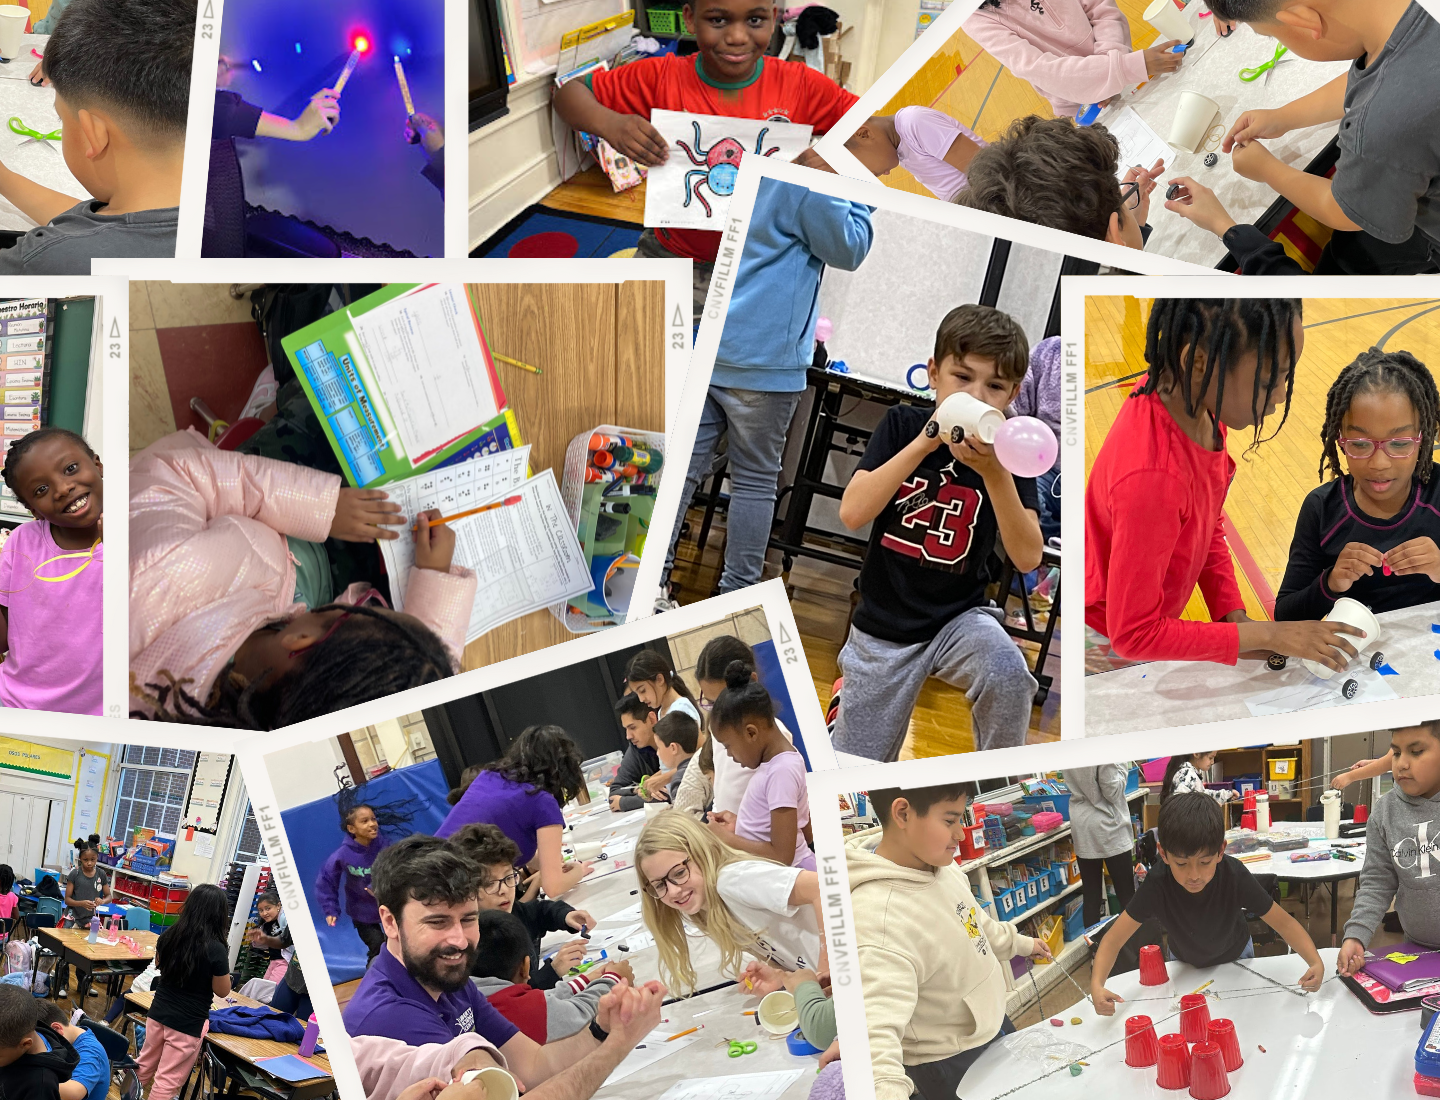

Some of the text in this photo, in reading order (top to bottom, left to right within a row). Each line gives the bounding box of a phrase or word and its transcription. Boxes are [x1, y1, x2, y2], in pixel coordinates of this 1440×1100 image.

[19, 301, 44, 311] Horario
[342, 357, 385, 448] Units of Measurement
[514, 455, 522, 479] The
[1390, 842, 1439, 858] Calvin Klein
